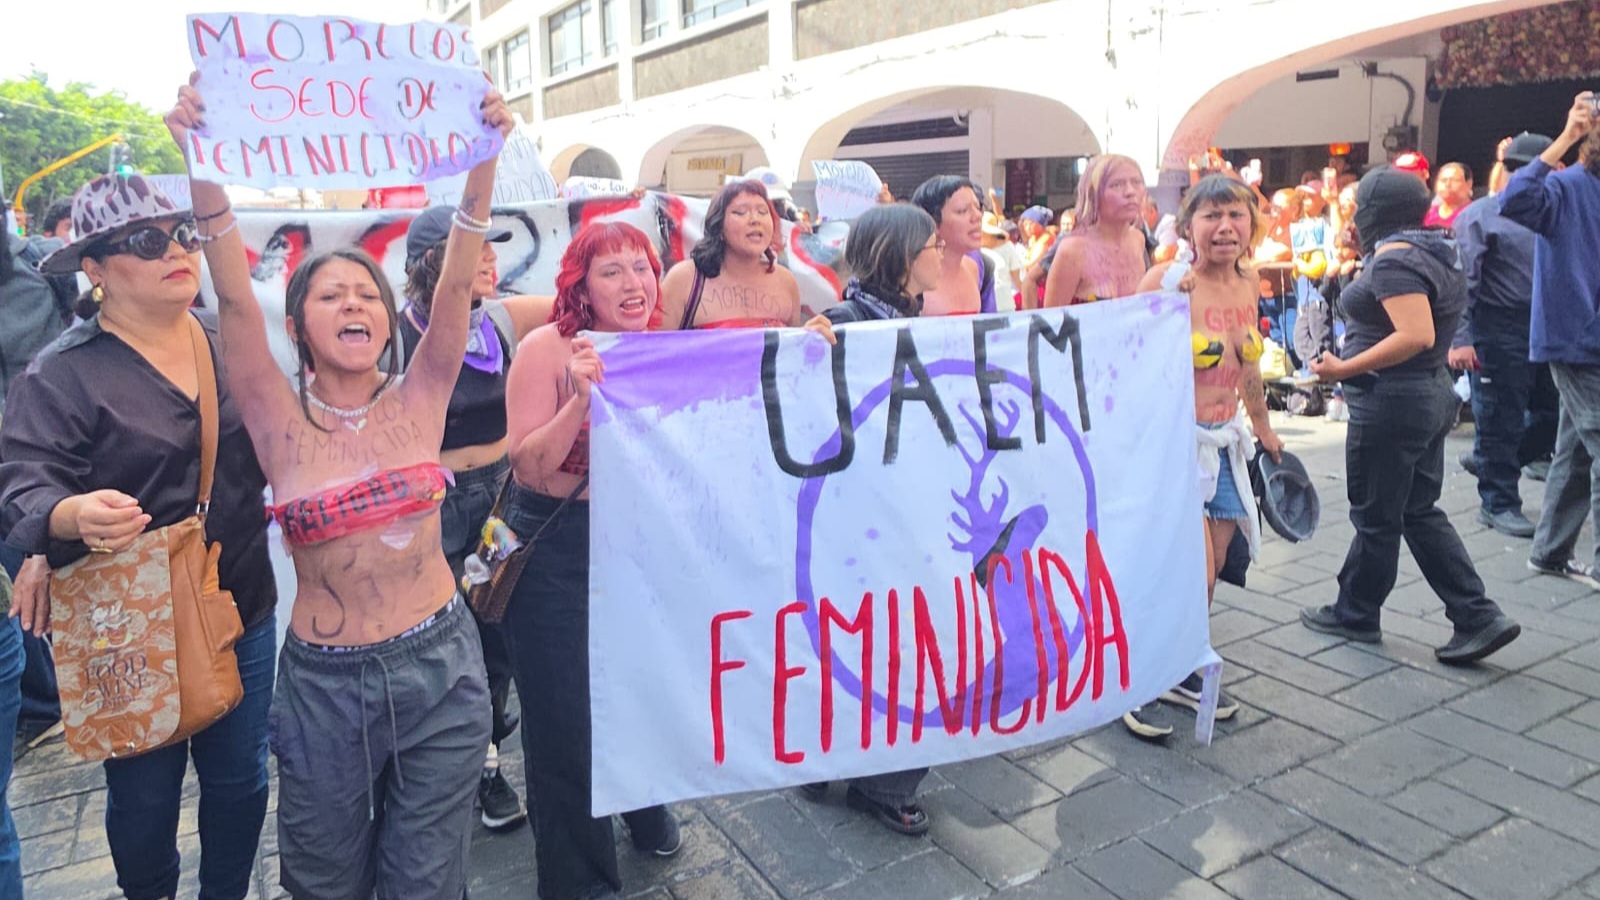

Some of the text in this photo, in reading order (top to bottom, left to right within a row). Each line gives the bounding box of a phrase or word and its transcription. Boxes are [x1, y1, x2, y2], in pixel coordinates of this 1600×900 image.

[250, 68, 437, 123] SEDE DE
[192, 131, 497, 178] FEMINICIDIOS
[700, 285, 782, 316] MORELOS
[1204, 304, 1256, 333] GENO
[760, 312, 1091, 479] UAEM
[710, 528, 1131, 766] FEMINICIDA
